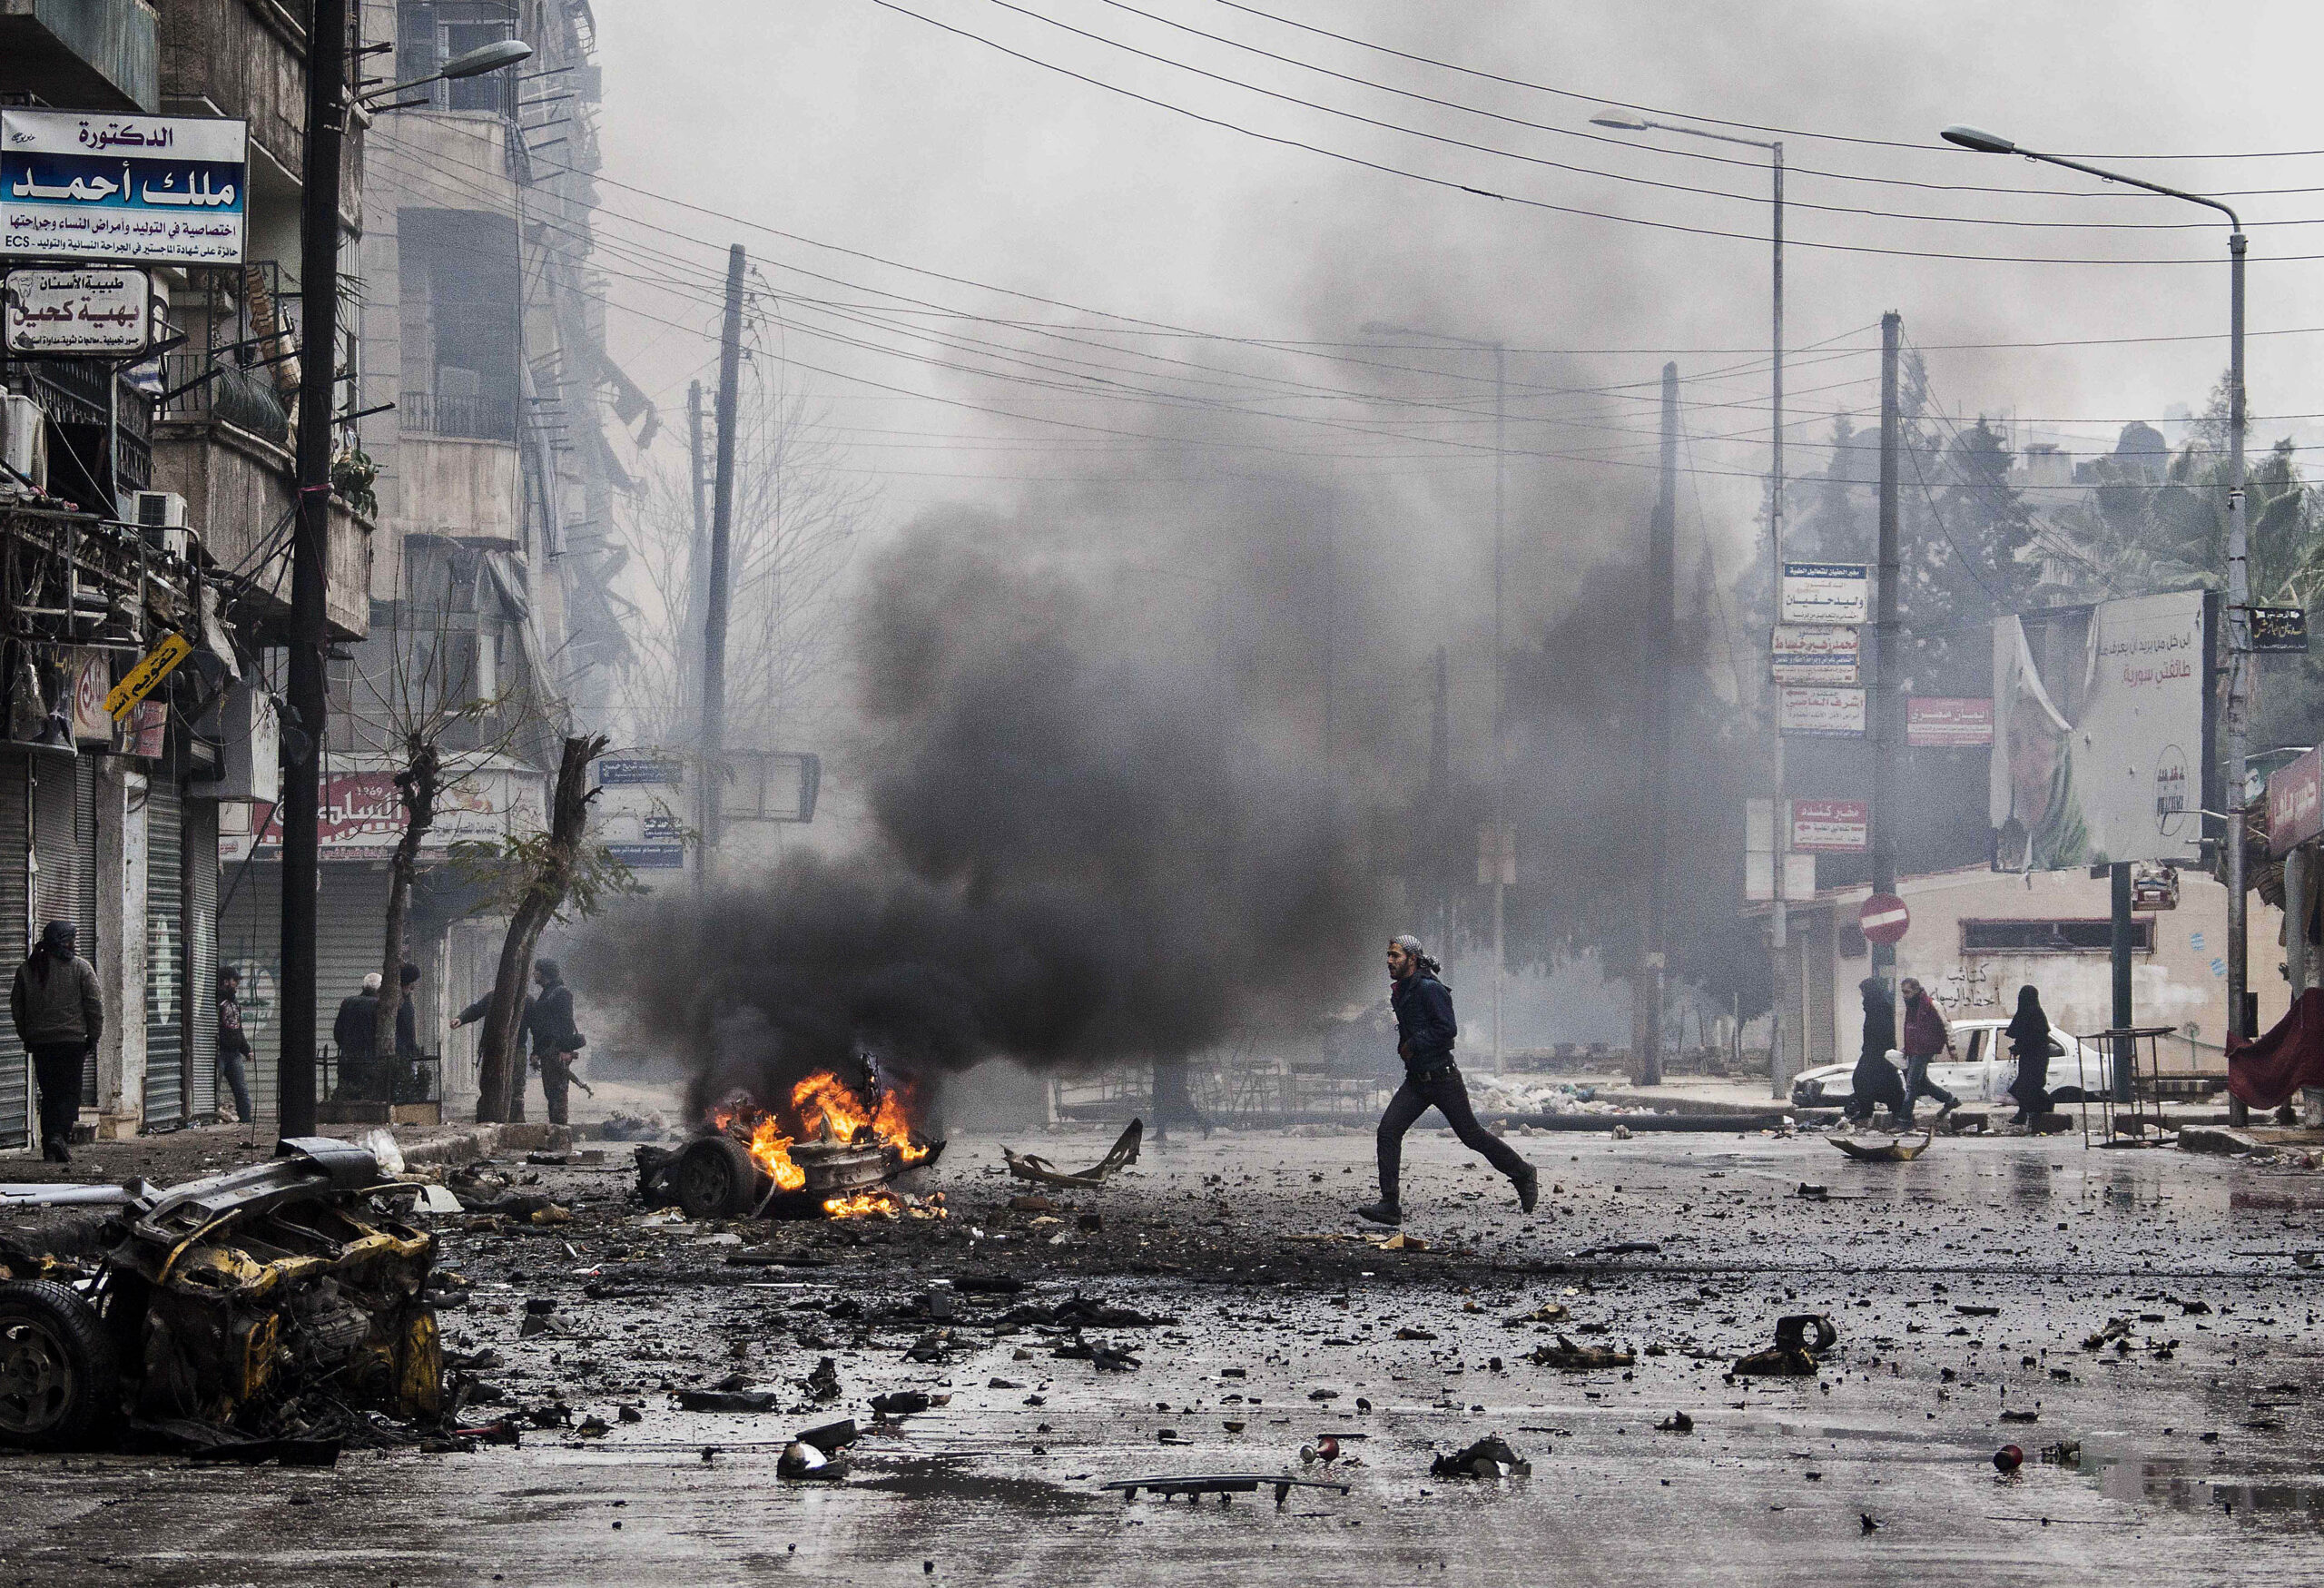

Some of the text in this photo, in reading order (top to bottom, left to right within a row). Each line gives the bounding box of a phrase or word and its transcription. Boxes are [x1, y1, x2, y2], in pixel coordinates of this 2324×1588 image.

[79, 121, 173, 150] الدكتورة
[12, 160, 236, 206] ملك أحمد
[10, 214, 236, 239] اختصاصية في التوليد وأمراض النساء وجراحتها
[5, 235, 30, 248] ECS
[36, 238, 66, 250] والتوليد
[101, 241, 132, 253] الجراحة
[133, 242, 142, 254] في
[143, 243, 175, 255] الماجستير
[176, 244, 199, 256] شهادة
[201, 246, 216, 257] على
[39, 273, 123, 293] طبيبة الأسنان
[77, 296, 140, 329] بهية
[124, 337, 140, 346] جسور
[1786, 594, 1864, 609] وليد حفيان
[132, 647, 178, 697] تقويم
[1946, 962, 1990, 985] كتائب
